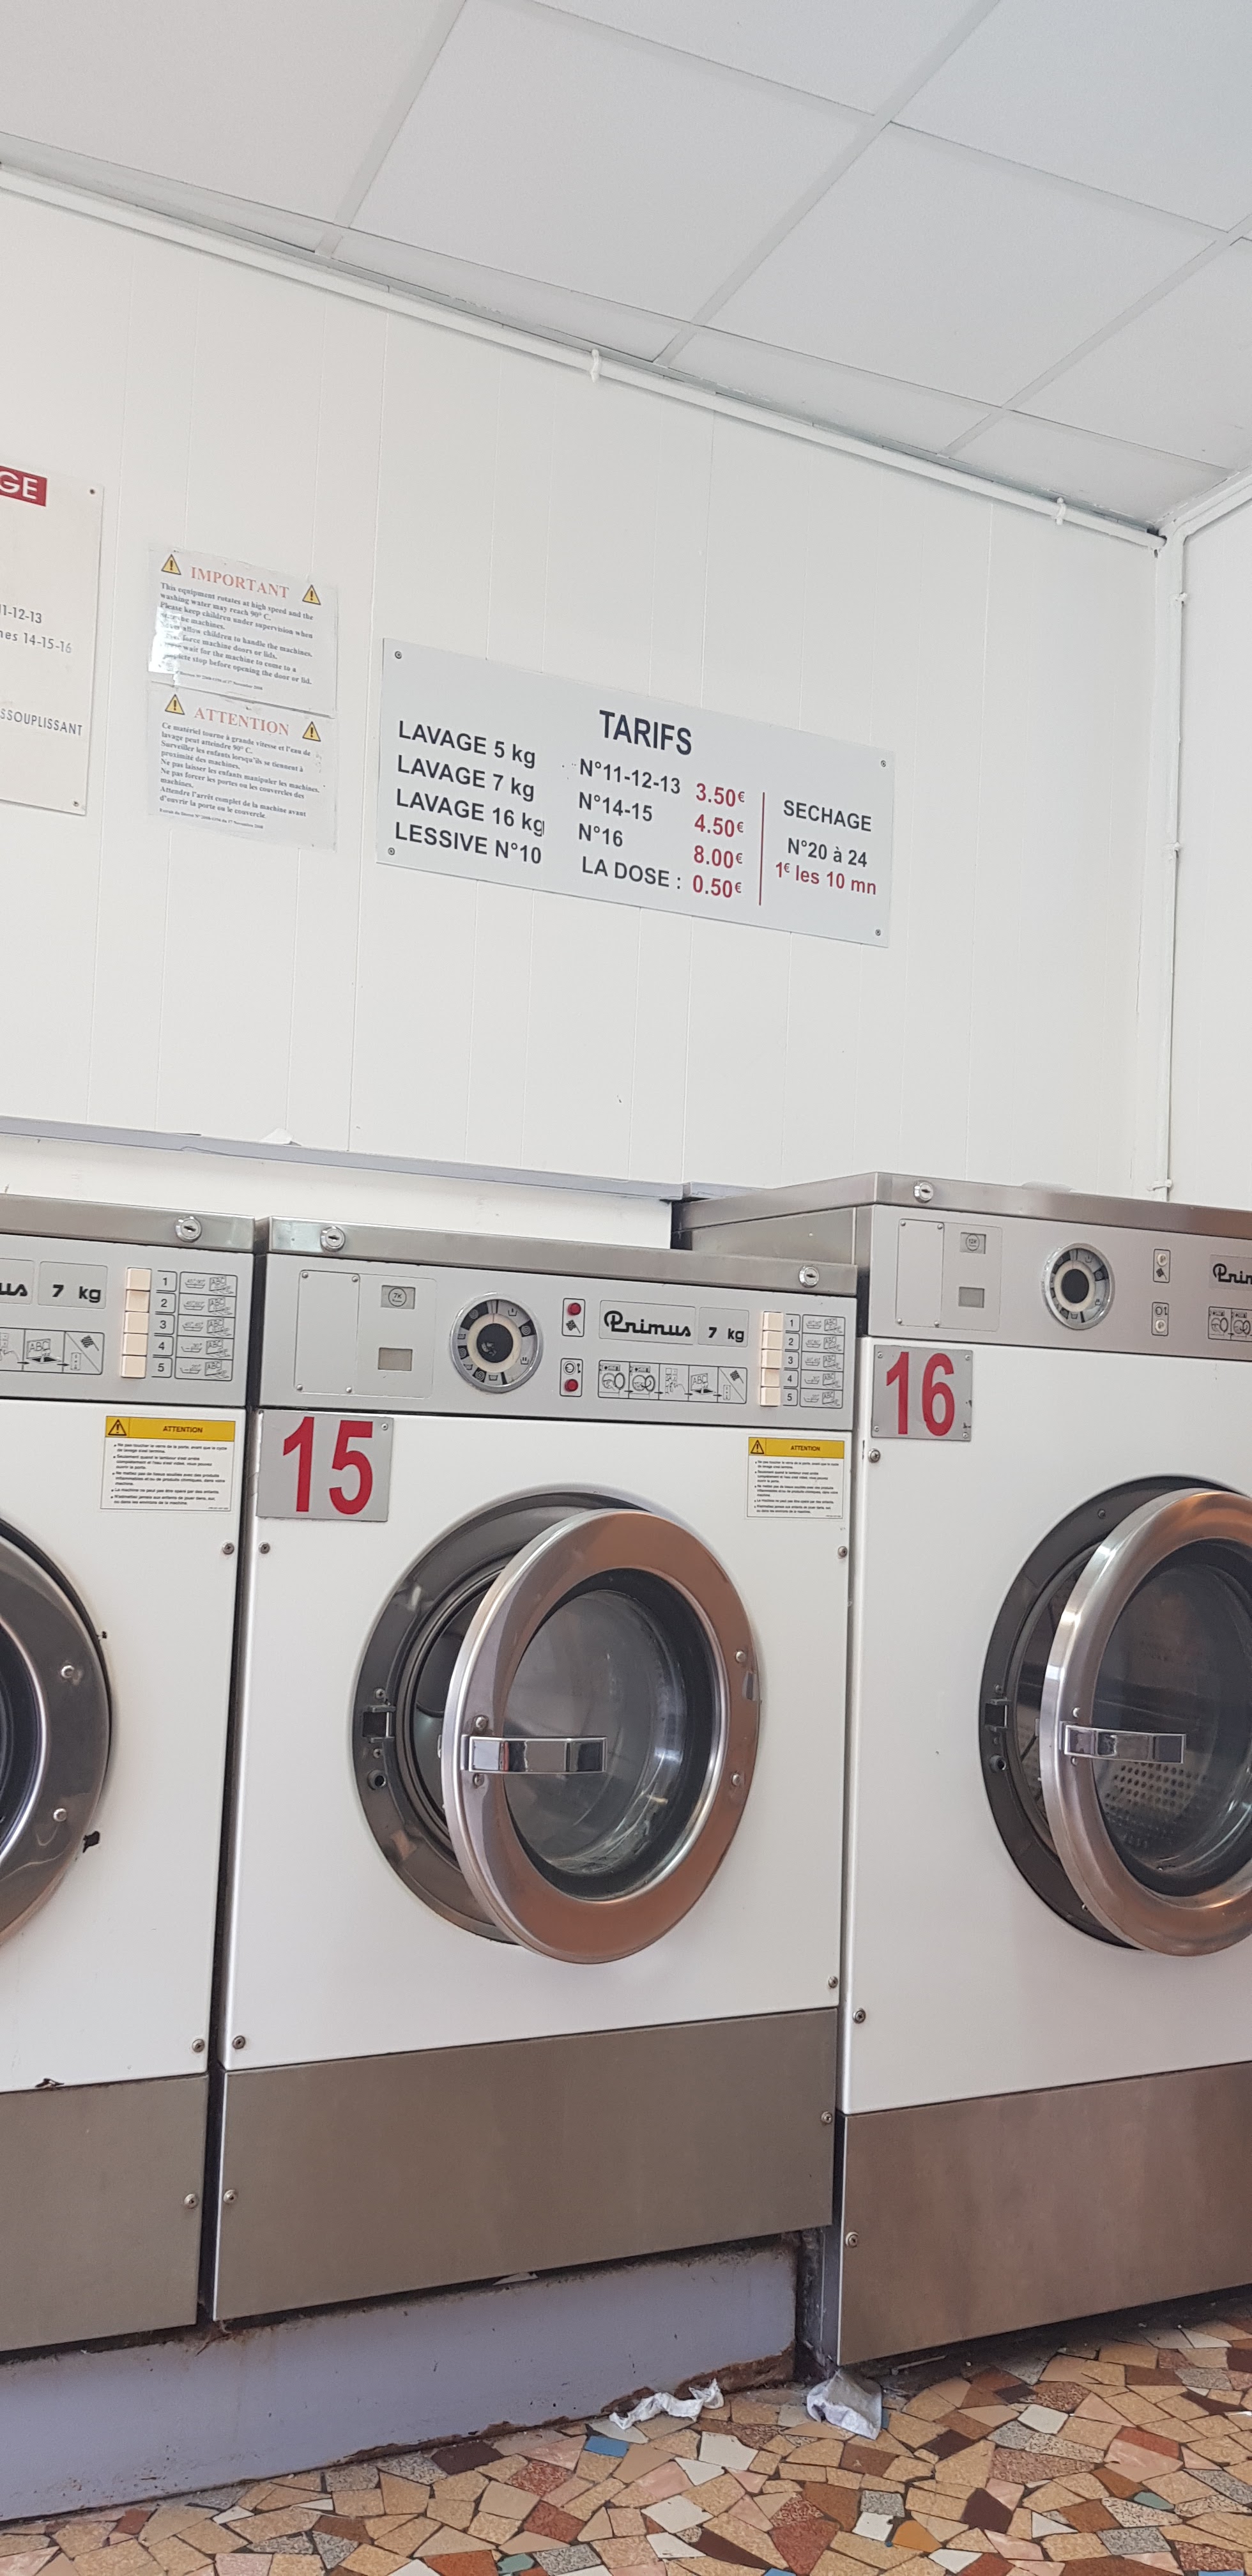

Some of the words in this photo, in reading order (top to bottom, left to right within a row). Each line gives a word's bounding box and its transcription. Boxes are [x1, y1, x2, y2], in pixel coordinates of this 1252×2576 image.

[191, 567, 289, 599] IMPORTANT
[160, 593, 189, 605] washing
[191, 599, 211, 608] water
[213, 604, 227, 613] may
[230, 608, 248, 616] reach
[161, 581, 176, 592] This
[178, 588, 215, 600] equipment
[217, 595, 240, 605] rotates
[252, 601, 266, 611] high
[268, 606, 286, 615] speed
[160, 601, 182, 612] Please
[184, 606, 200, 617] keep
[202, 610, 231, 622] children
[233, 618, 253, 626] under
[256, 622, 293, 635] supervision
[296, 630, 312, 639] when
[191, 618, 225, 630] machines.
[24, 632, 72, 654] 14-15-16
[183, 625, 200, 634] allow
[204, 629, 231, 641] children
[243, 637, 265, 648] handle
[268, 642, 278, 650] the
[280, 646, 312, 657] machines.
[183, 634, 200, 644] force
[202, 640, 231, 650] machine
[233, 645, 252, 654] doors
[264, 650, 277, 660] lids.
[201, 647, 211, 656] for
[225, 654, 254, 664] machine
[193, 657, 207, 666] stop
[210, 658, 231, 669] before
[233, 665, 259, 677] opening
[274, 672, 289, 680] door
[302, 677, 312, 685] lid.
[0, 708, 82, 736] SSOUPLISSANT
[194, 707, 289, 735] ATTENTION
[600, 710, 691, 755] TARIFS
[162, 731, 183, 742] lavage
[202, 740, 231, 750] atteindre
[174, 726, 201, 735] matériel
[203, 730, 224, 740] tourne
[232, 737, 254, 746] grande
[256, 740, 276, 749] vitesse
[399, 721, 486, 755] LAVAGE
[494, 741, 504, 758] 5
[513, 744, 535, 769] kg
[162, 740, 194, 752] Surveiller
[207, 750, 230, 759] enfants
[272, 761, 298, 772] tiennent
[162, 751, 194, 761] proximité
[195, 755, 206, 763] des
[208, 759, 240, 770] machines.
[161, 758, 170, 766] Ne
[185, 762, 206, 772] laisser
[218, 770, 241, 779] enfants
[244, 775, 277, 785] manipuler
[289, 783, 319, 793] machines.
[161, 778, 194, 788] machines.
[185, 772, 205, 781] forcer
[218, 779, 238, 787] portes
[259, 786, 292, 797] couvercles
[399, 755, 485, 788] LAVAGE
[493, 774, 503, 790] 7
[512, 778, 533, 802] kg
[581, 758, 680, 793] N°11-12-13
[696, 783, 744, 807] 3.50€
[160, 786, 190, 797] Attendre
[215, 797, 241, 806] complet
[260, 804, 286, 813] machine
[397, 788, 484, 821] LAVAGE
[493, 808, 514, 826] 16
[523, 813, 544, 836] kg
[579, 792, 652, 821] N°14-15
[694, 814, 743, 837] 4.50€
[784, 800, 871, 832] SECHAGE
[396, 822, 487, 854] LESSIVE
[496, 840, 541, 864] N°10
[579, 824, 622, 847] N°16
[694, 845, 742, 868] 8.00€
[788, 838, 827, 859] N°20
[834, 847, 841, 862] à
[848, 850, 867, 867] 24
[583, 856, 607, 877] LA
[615, 862, 669, 887] DOSE
[693, 875, 741, 898] 0.50€
[796, 865, 819, 884] les
[827, 871, 844, 889] 10
[851, 880, 876, 894] mn
[52, 1285, 64, 1298] 7
[79, 1286, 101, 1303] kg
[163, 1277, 167, 1285] 1
[161, 1298, 167, 1307] 2
[160, 1320, 166, 1329] 3
[604, 1310, 691, 1337] Primus
[708, 1327, 717, 1338] 7
[728, 1328, 744, 1342] kg
[158, 1342, 165, 1350] 4
[157, 1363, 164, 1372] 5
[886, 1351, 955, 1436] 16
[283, 1416, 373, 1515] 15
